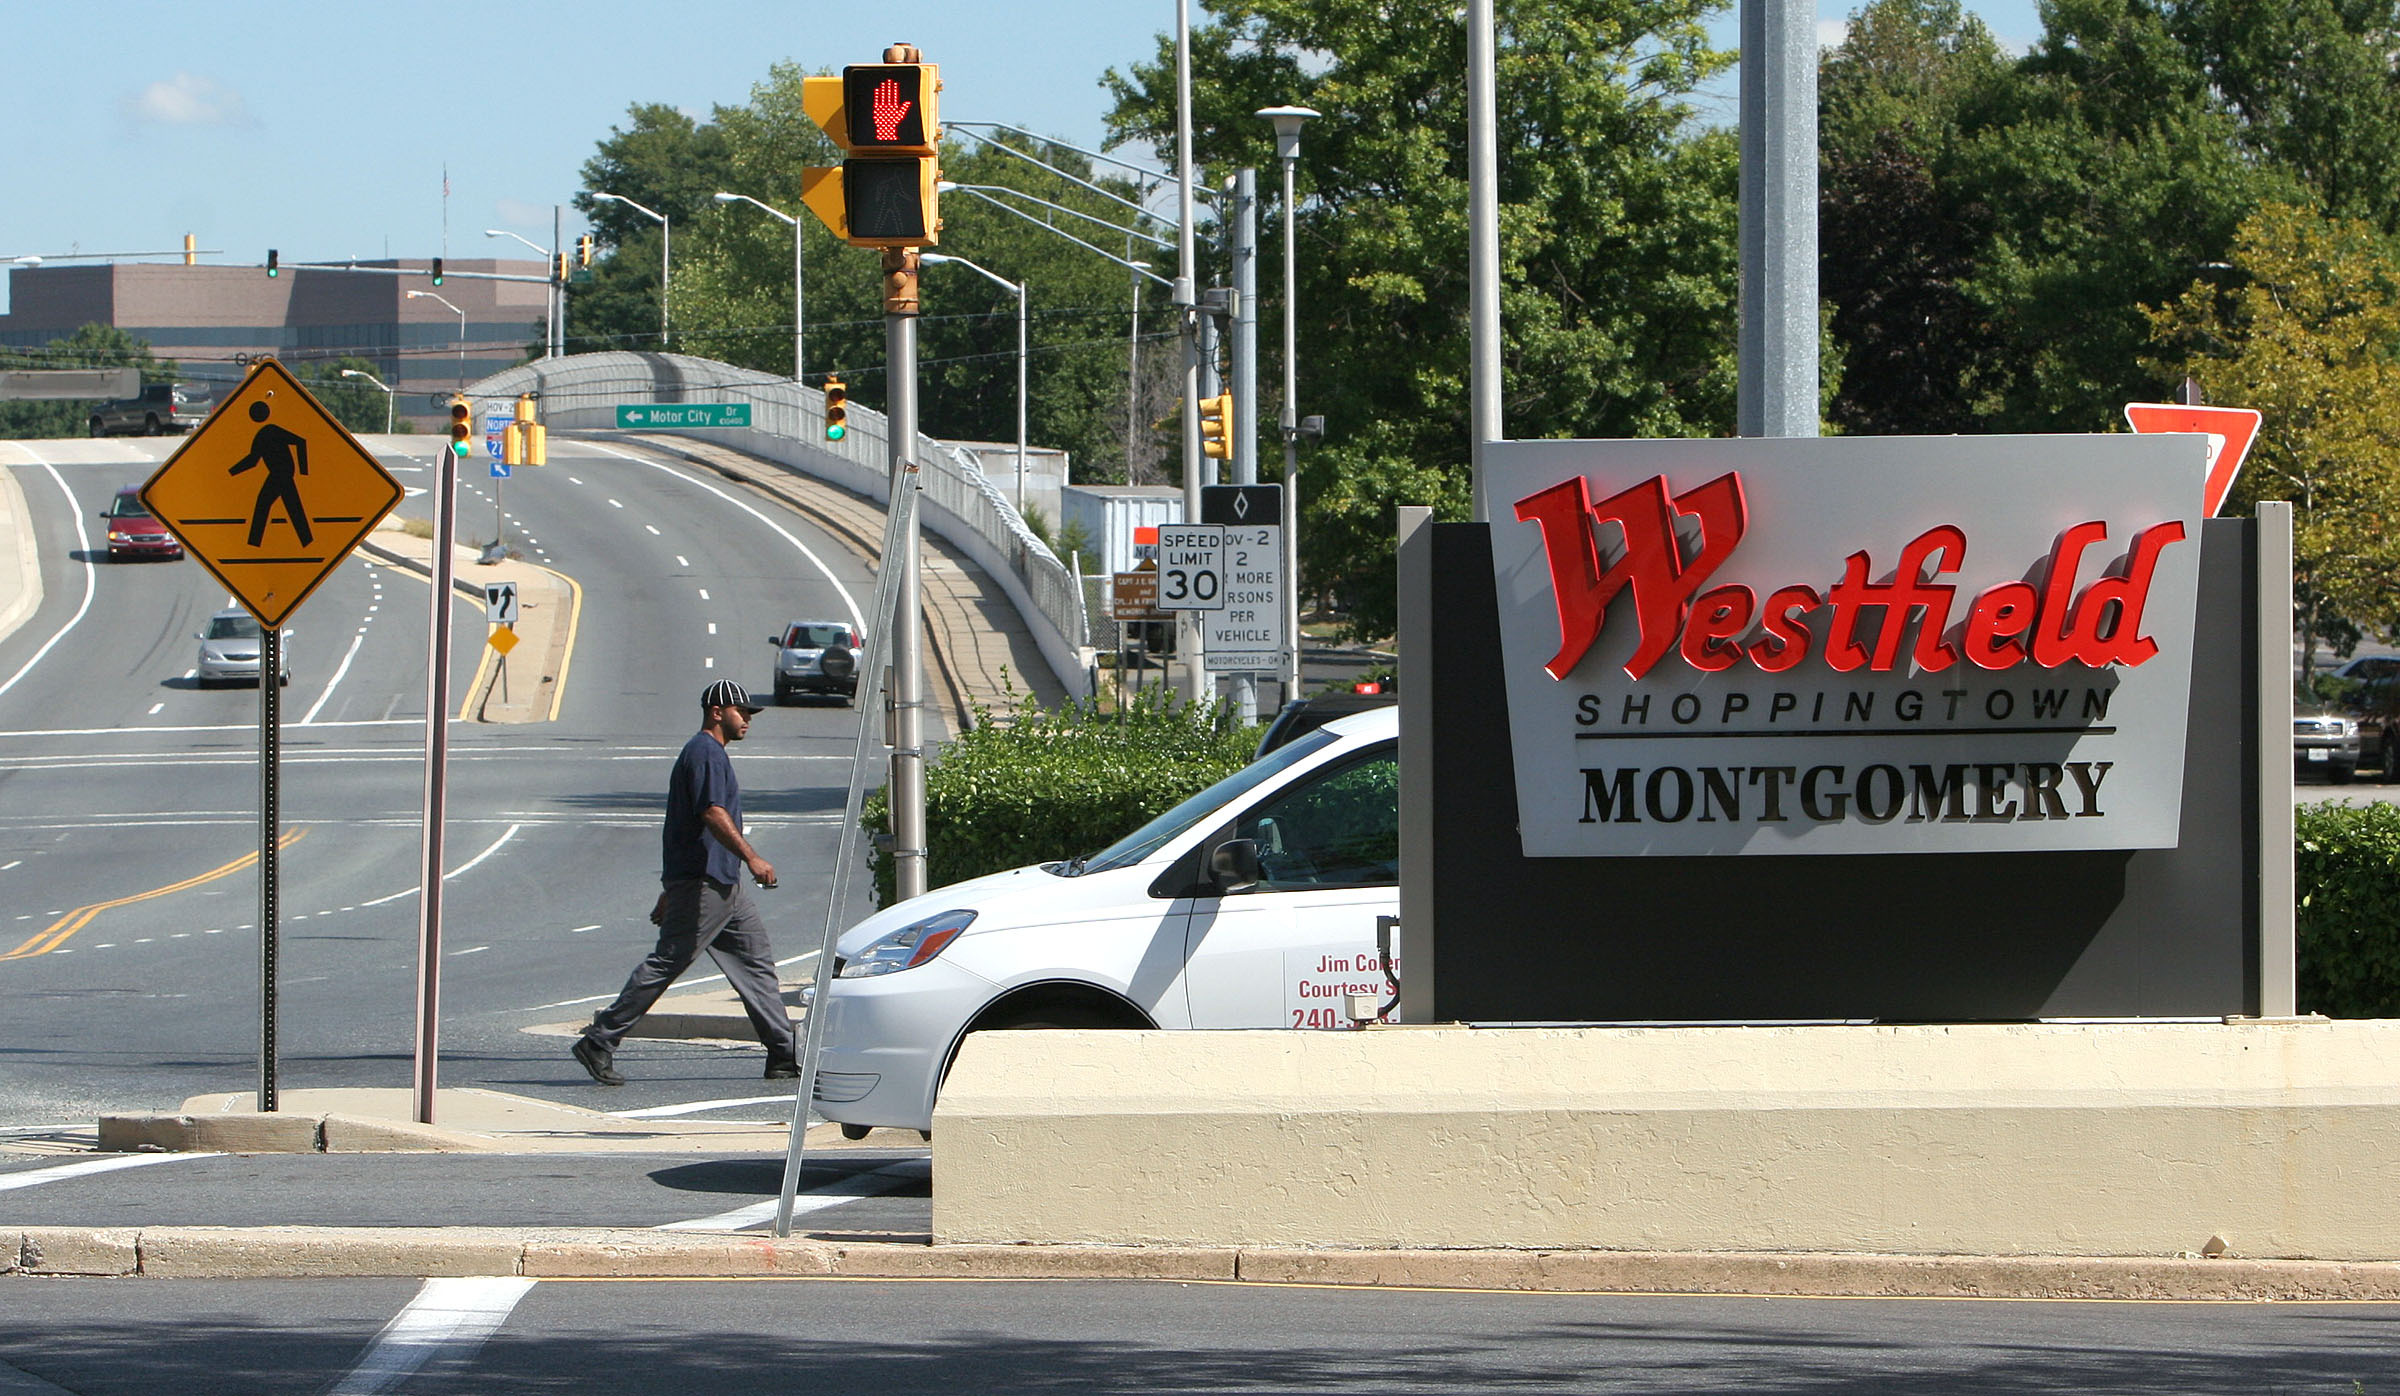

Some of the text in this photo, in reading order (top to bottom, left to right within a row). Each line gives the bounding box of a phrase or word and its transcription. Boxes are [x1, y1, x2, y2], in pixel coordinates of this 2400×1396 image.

[650, 406, 737, 425] Motor City Dr
[1164, 534, 1220, 547] SPEED
[1170, 552, 1213, 565] LIMIT
[1236, 551, 1248, 566] 2
[1165, 569, 1218, 600] 30
[1236, 571, 1273, 584] MORE
[1514, 471, 2187, 682] Westfield
[1230, 610, 1254, 622] PER
[1215, 629, 1271, 642] VEHICLE
[1575, 689, 2112, 726] SHOPPINGTOWN
[1578, 761, 2113, 824] MONTGOMERY
[1316, 954, 1349, 973] Jim
[1299, 980, 1379, 998] Courtesy
